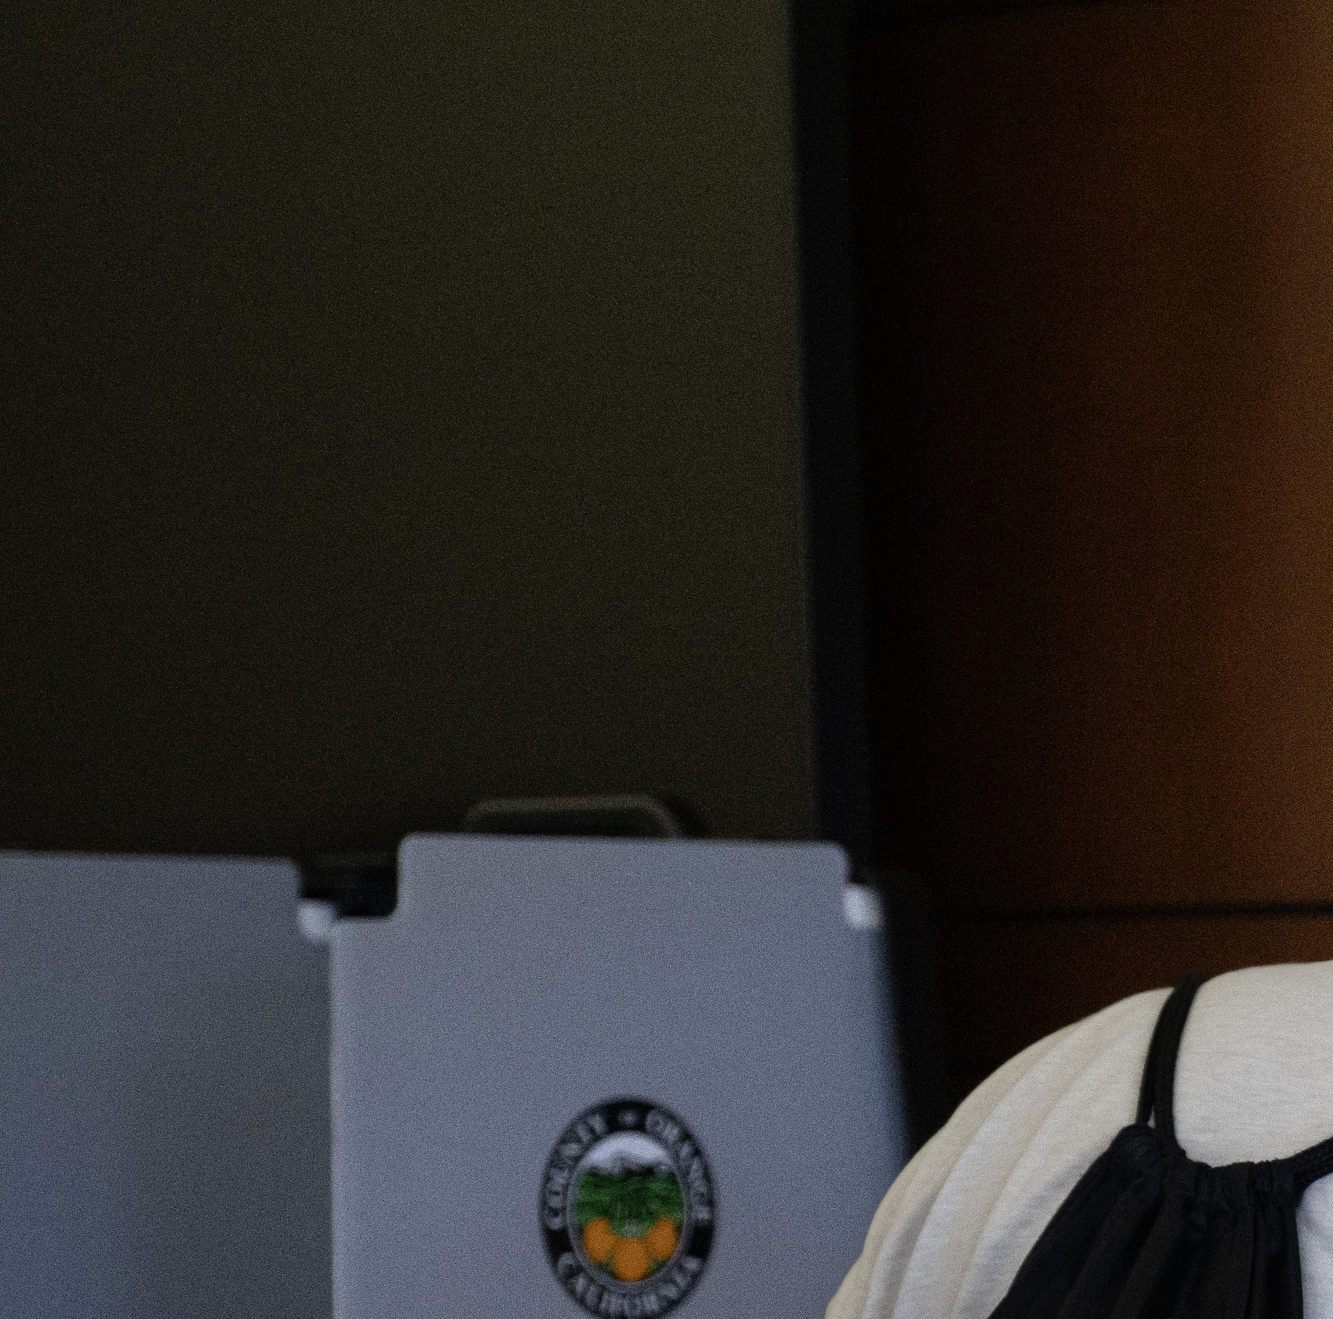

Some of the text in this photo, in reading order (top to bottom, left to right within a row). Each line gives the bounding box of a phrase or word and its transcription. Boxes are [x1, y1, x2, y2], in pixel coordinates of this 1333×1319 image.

[547, 1109, 712, 1232] COUNTY ORANGE
[558, 1252, 701, 1318] CALIFORNIA
